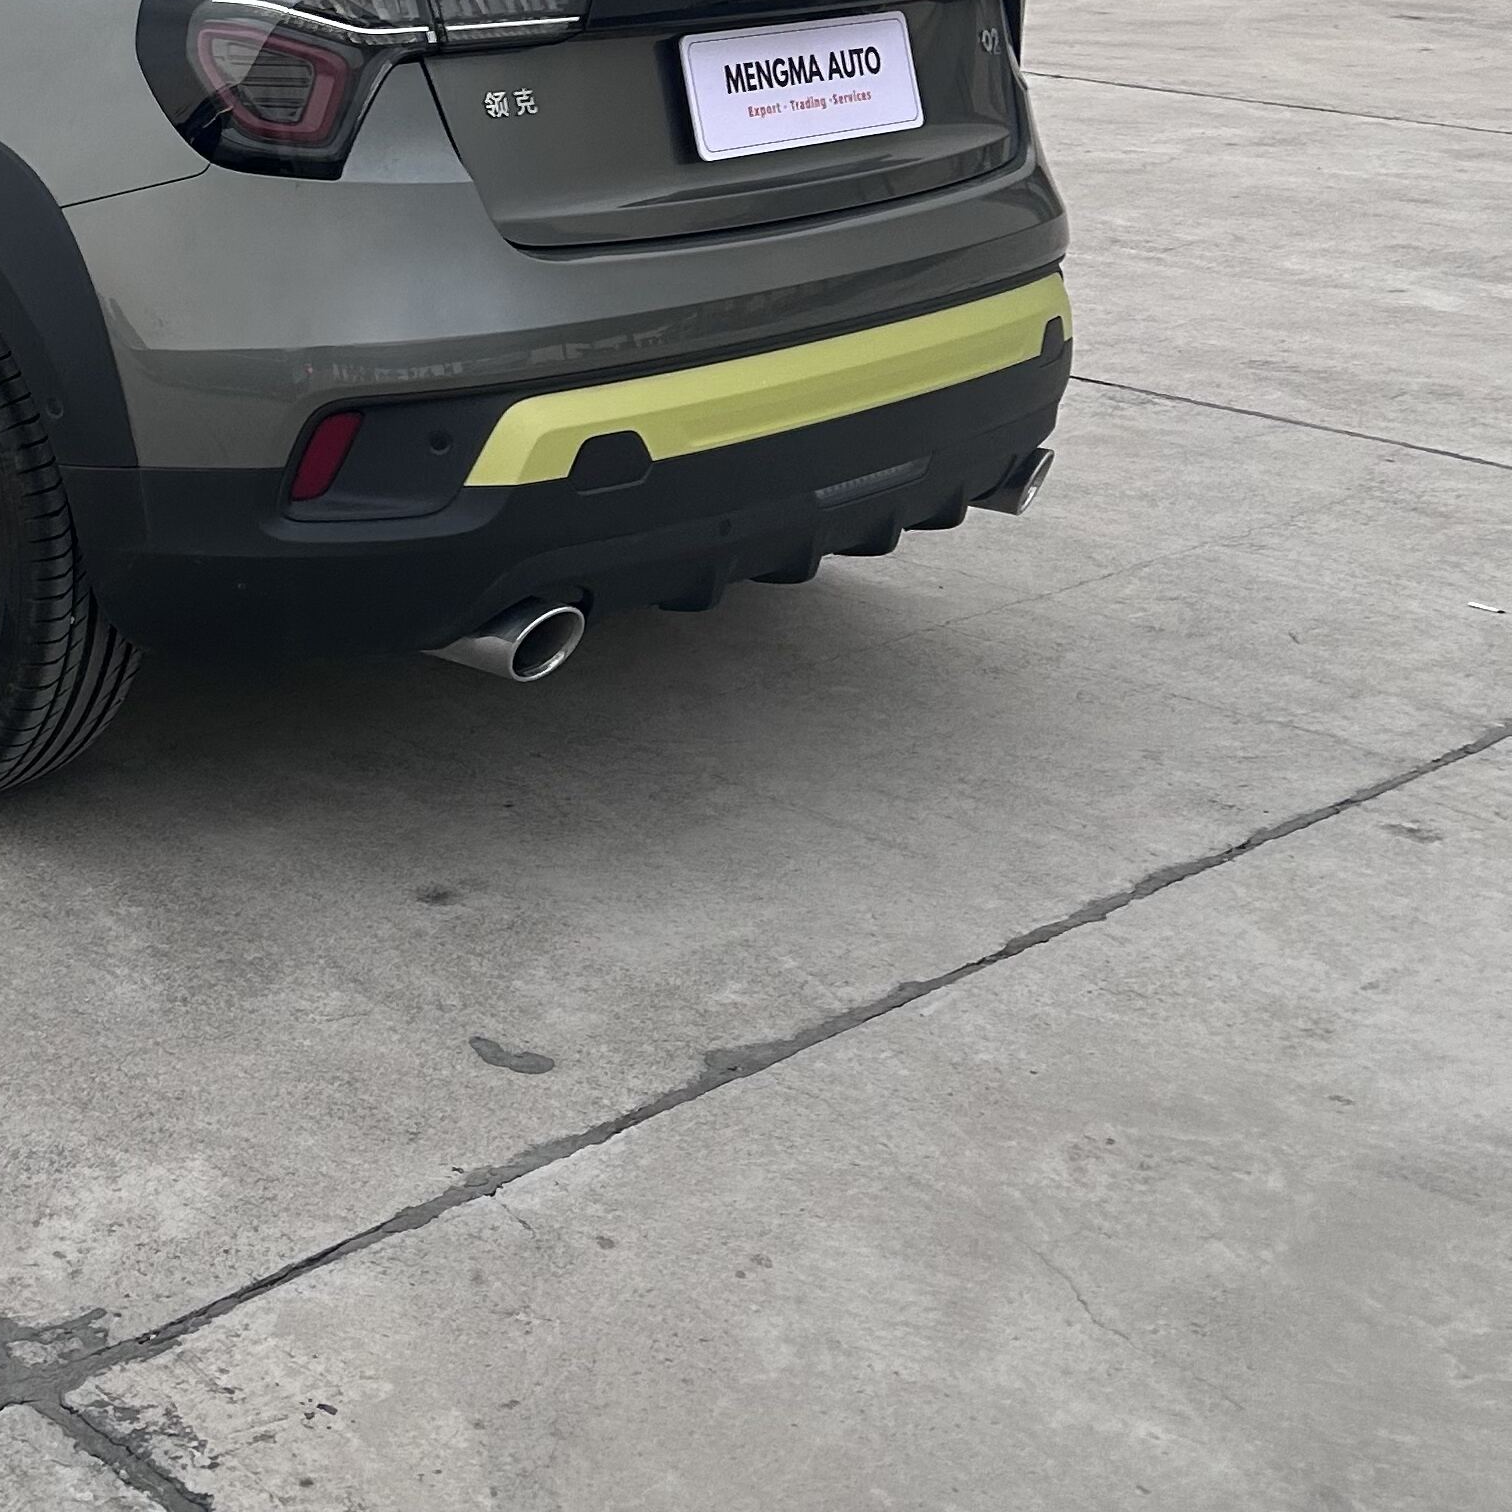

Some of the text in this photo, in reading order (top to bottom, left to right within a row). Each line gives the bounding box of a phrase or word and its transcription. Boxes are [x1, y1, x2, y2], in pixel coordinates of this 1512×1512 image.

[724, 46, 881, 94] MENGMA AUTO
[484, 88, 538, 118] 领克
[748, 102, 782, 118] Export
[790, 96, 828, 111] Trading
